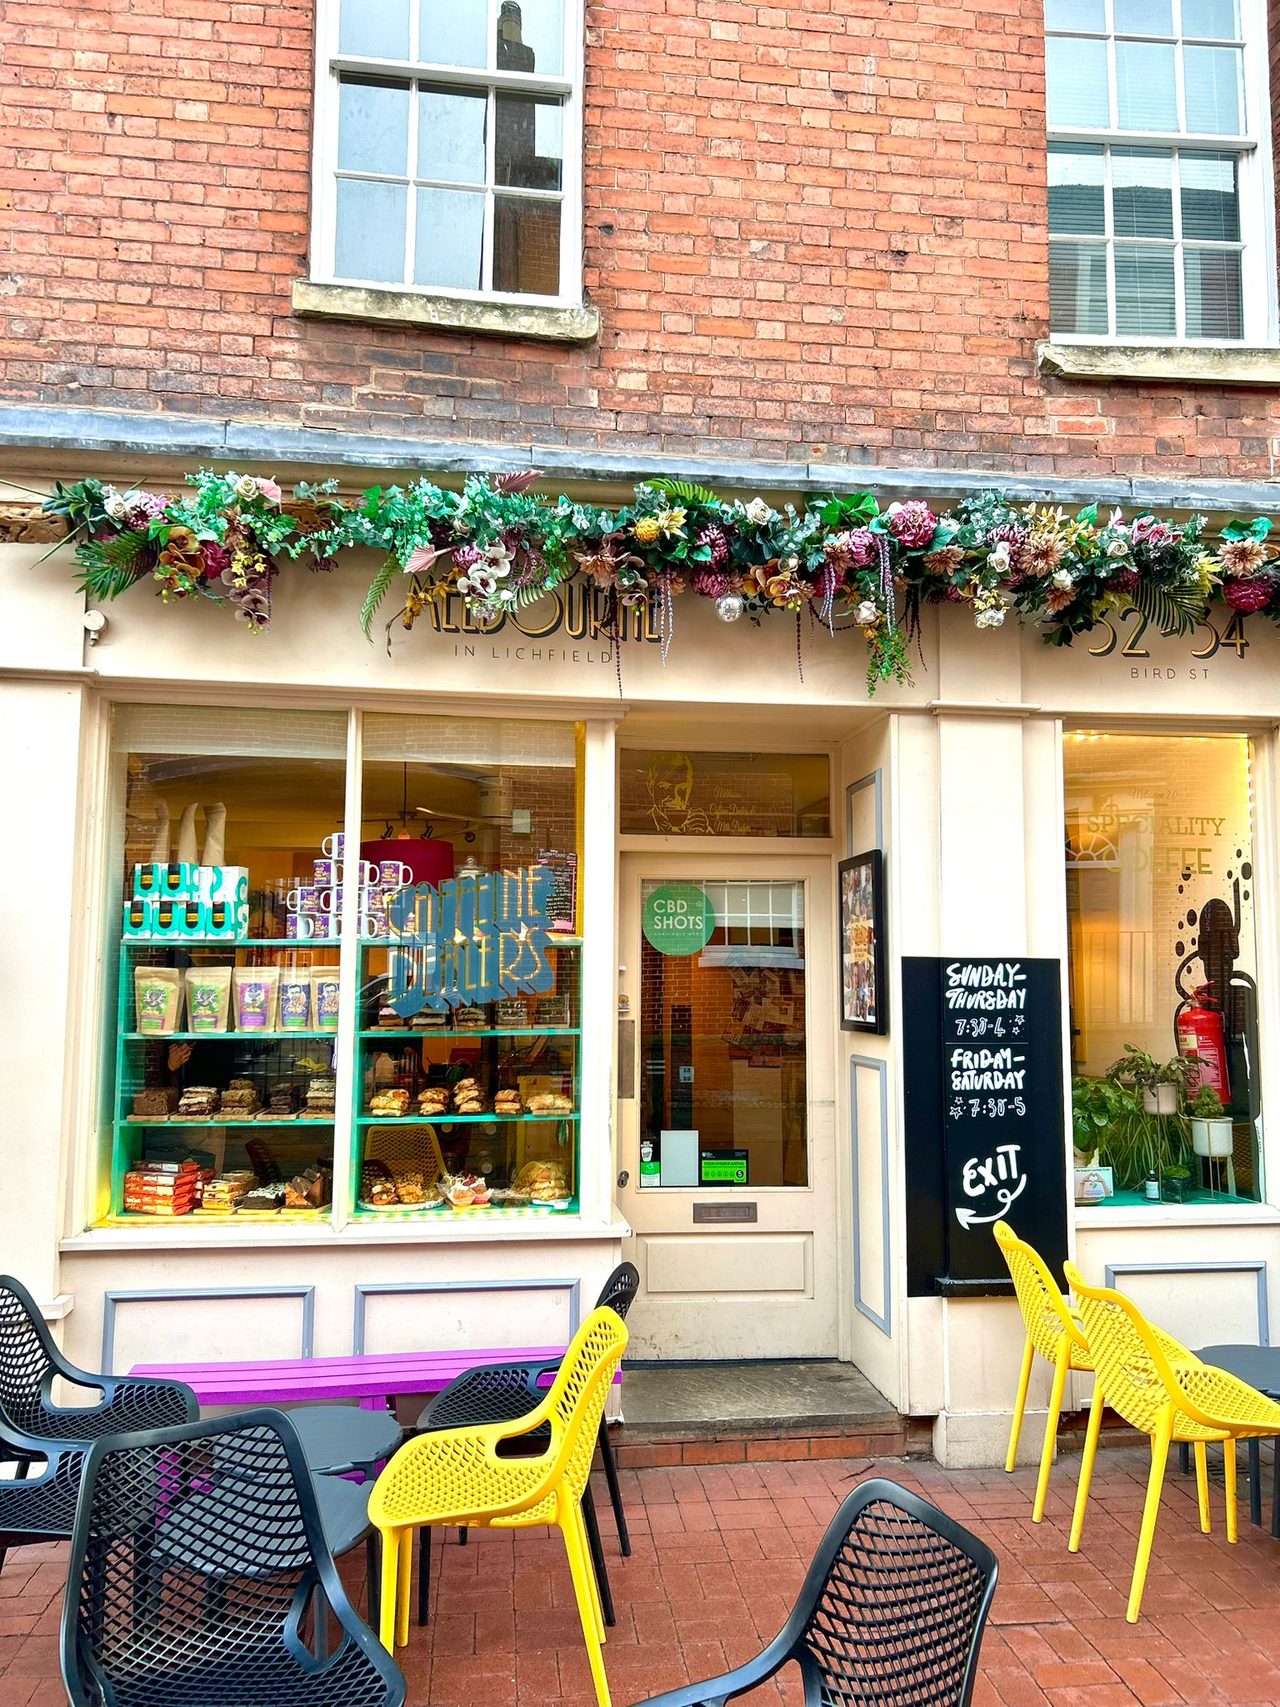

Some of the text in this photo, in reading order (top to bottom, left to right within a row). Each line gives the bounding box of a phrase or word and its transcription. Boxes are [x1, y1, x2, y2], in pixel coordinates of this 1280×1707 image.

[454, 645, 612, 664] IN LICHFIELD
[1130, 667, 1209, 680] BIRD ST
[1087, 814, 1226, 836] SPECIALITY
[1102, 847, 1213, 875] COFFEE
[384, 864, 552, 935] CAFFEINE
[653, 899, 687, 913] CBD
[654, 915, 703, 930] SHOTS
[386, 925, 552, 1008] DEALERS
[945, 988, 1026, 1011] THURSDAY
[951, 1069, 1026, 1091] SATURDAY
[962, 1144, 1022, 1198] EXIT
